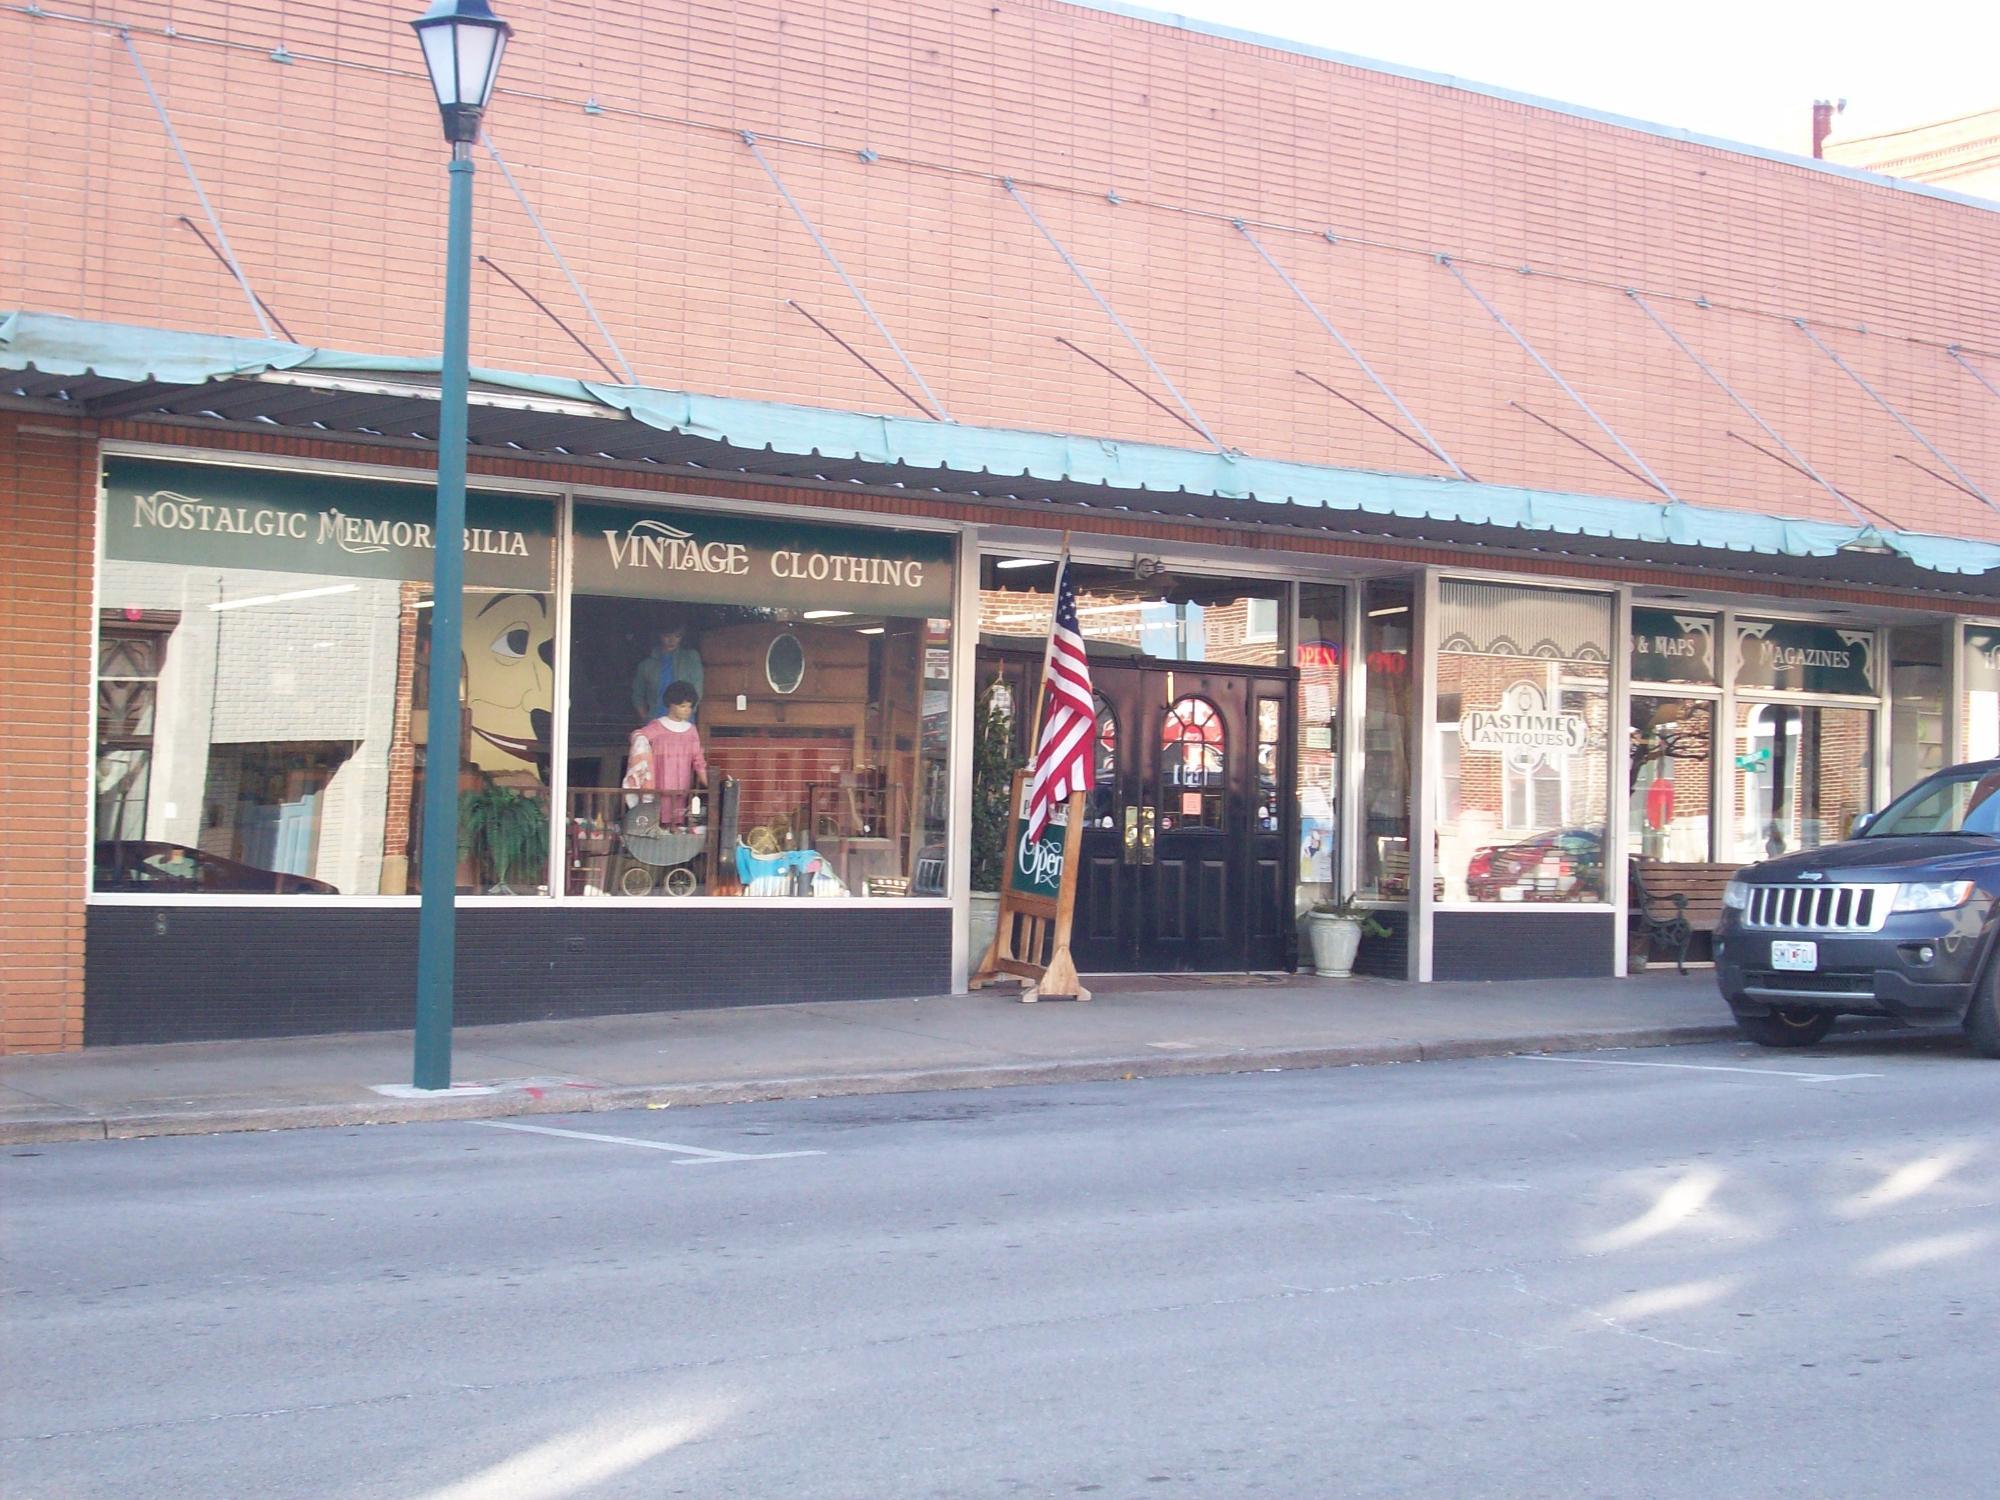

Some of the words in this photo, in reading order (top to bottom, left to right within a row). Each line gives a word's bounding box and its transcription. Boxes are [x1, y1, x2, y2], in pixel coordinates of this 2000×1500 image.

[133, 491, 307, 539] NOSTALGIC
[316, 507, 530, 557] MEMORILIA
[603, 520, 750, 576] VINTAGE
[771, 550, 924, 587] CLOTHING
[1654, 636, 1695, 658] MAPS
[1760, 640, 1851, 670] MAGAZINES
[1471, 712, 1577, 747] PASTIMES
[1480, 730, 1564, 748] ANTIQUES
[1018, 829, 1064, 889] Open
